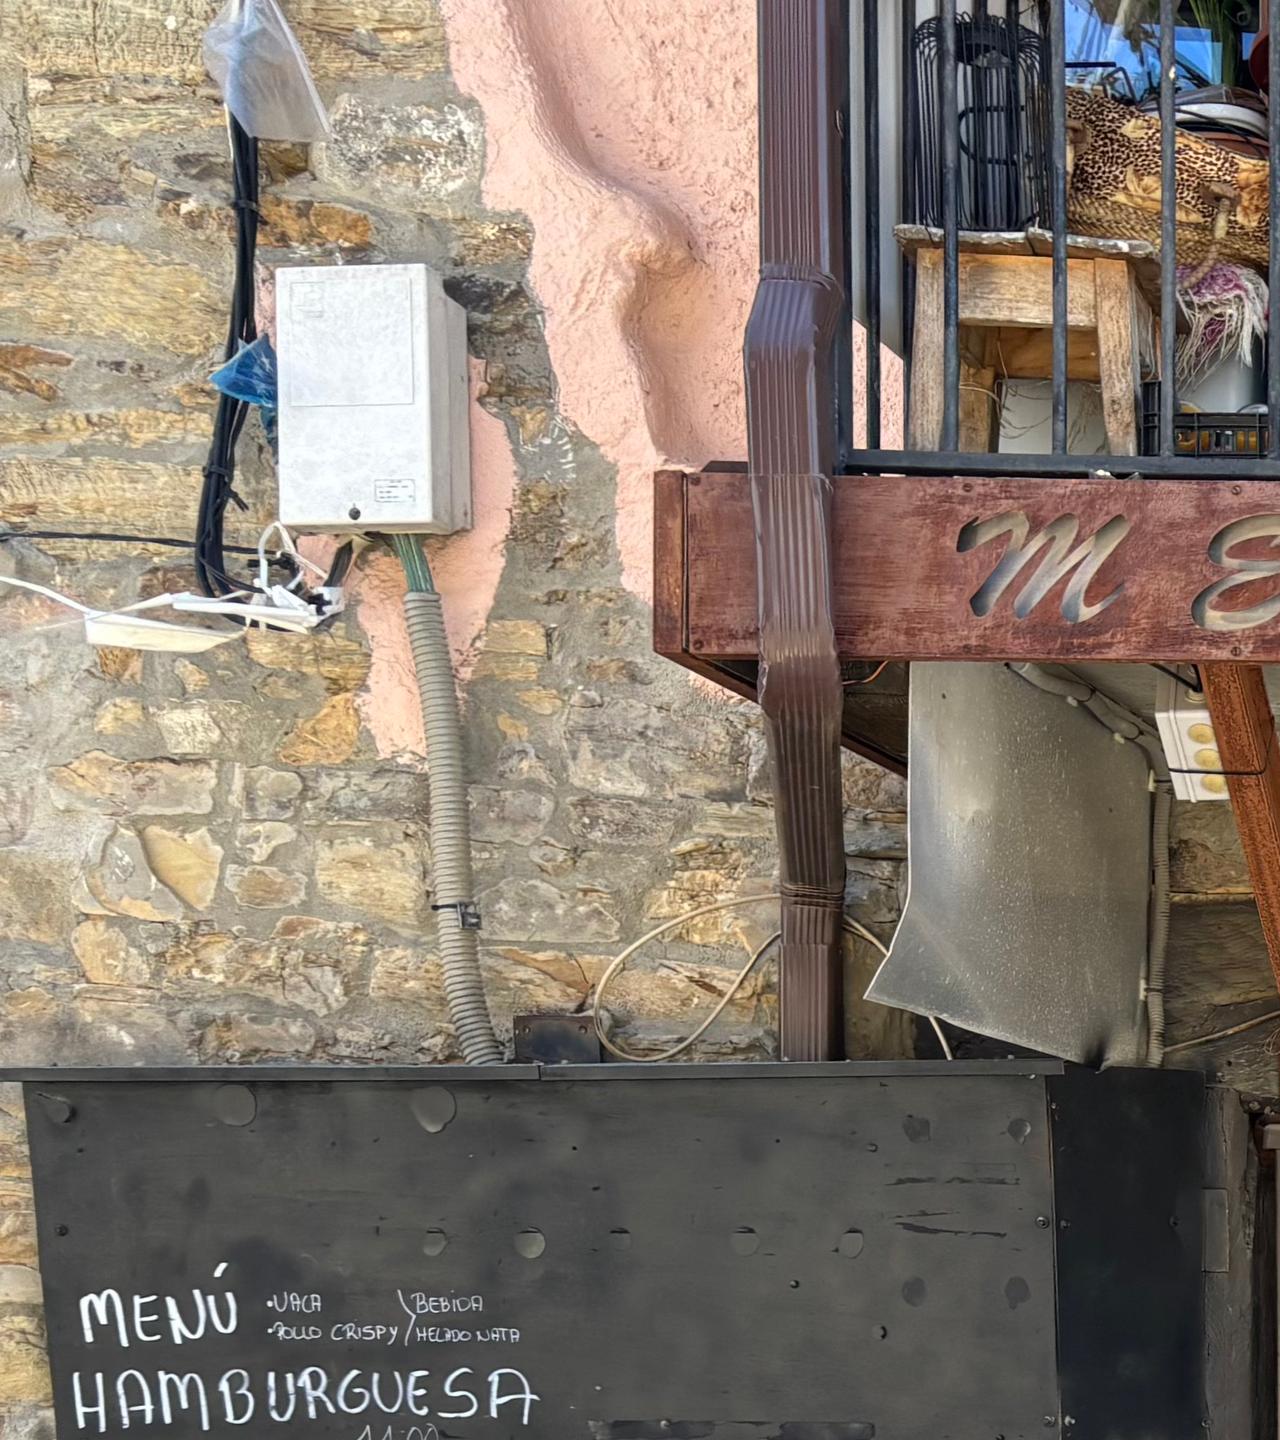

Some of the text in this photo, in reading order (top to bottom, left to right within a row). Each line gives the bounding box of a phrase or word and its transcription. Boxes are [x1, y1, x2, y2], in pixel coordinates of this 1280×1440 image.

[79, 1262, 238, 1347] MENÚ
[273, 1291, 322, 1313] VACA
[411, 1290, 484, 1314] BEBIDA
[272, 1321, 399, 1346] POLLO CRISPY
[416, 1326, 521, 1343] HELADO NATA
[72, 1365, 541, 1433] HAMBURGUESA
